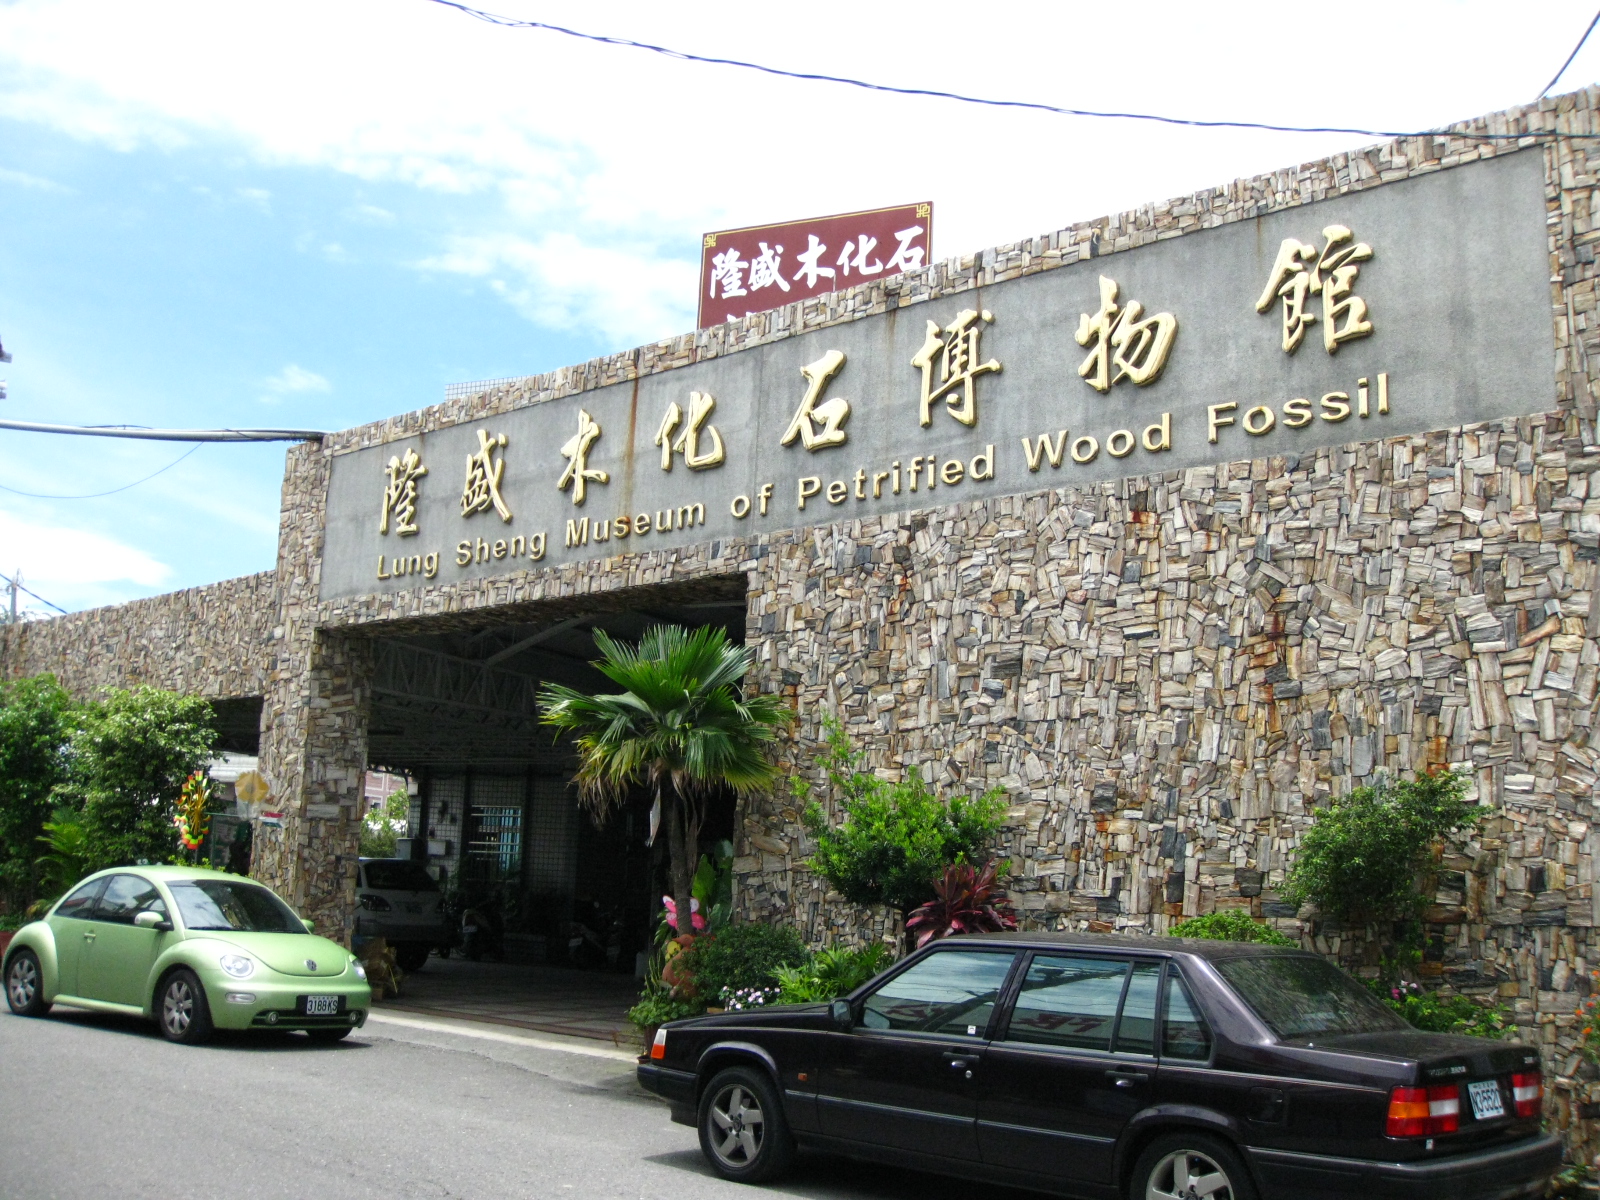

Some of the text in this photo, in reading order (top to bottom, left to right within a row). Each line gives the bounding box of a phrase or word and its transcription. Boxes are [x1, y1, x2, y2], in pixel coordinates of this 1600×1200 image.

[709, 225, 925, 300] 隆盛木化石
[377, 372, 1390, 580] Lung Sheng Museum of Petrified Wood Fossil
